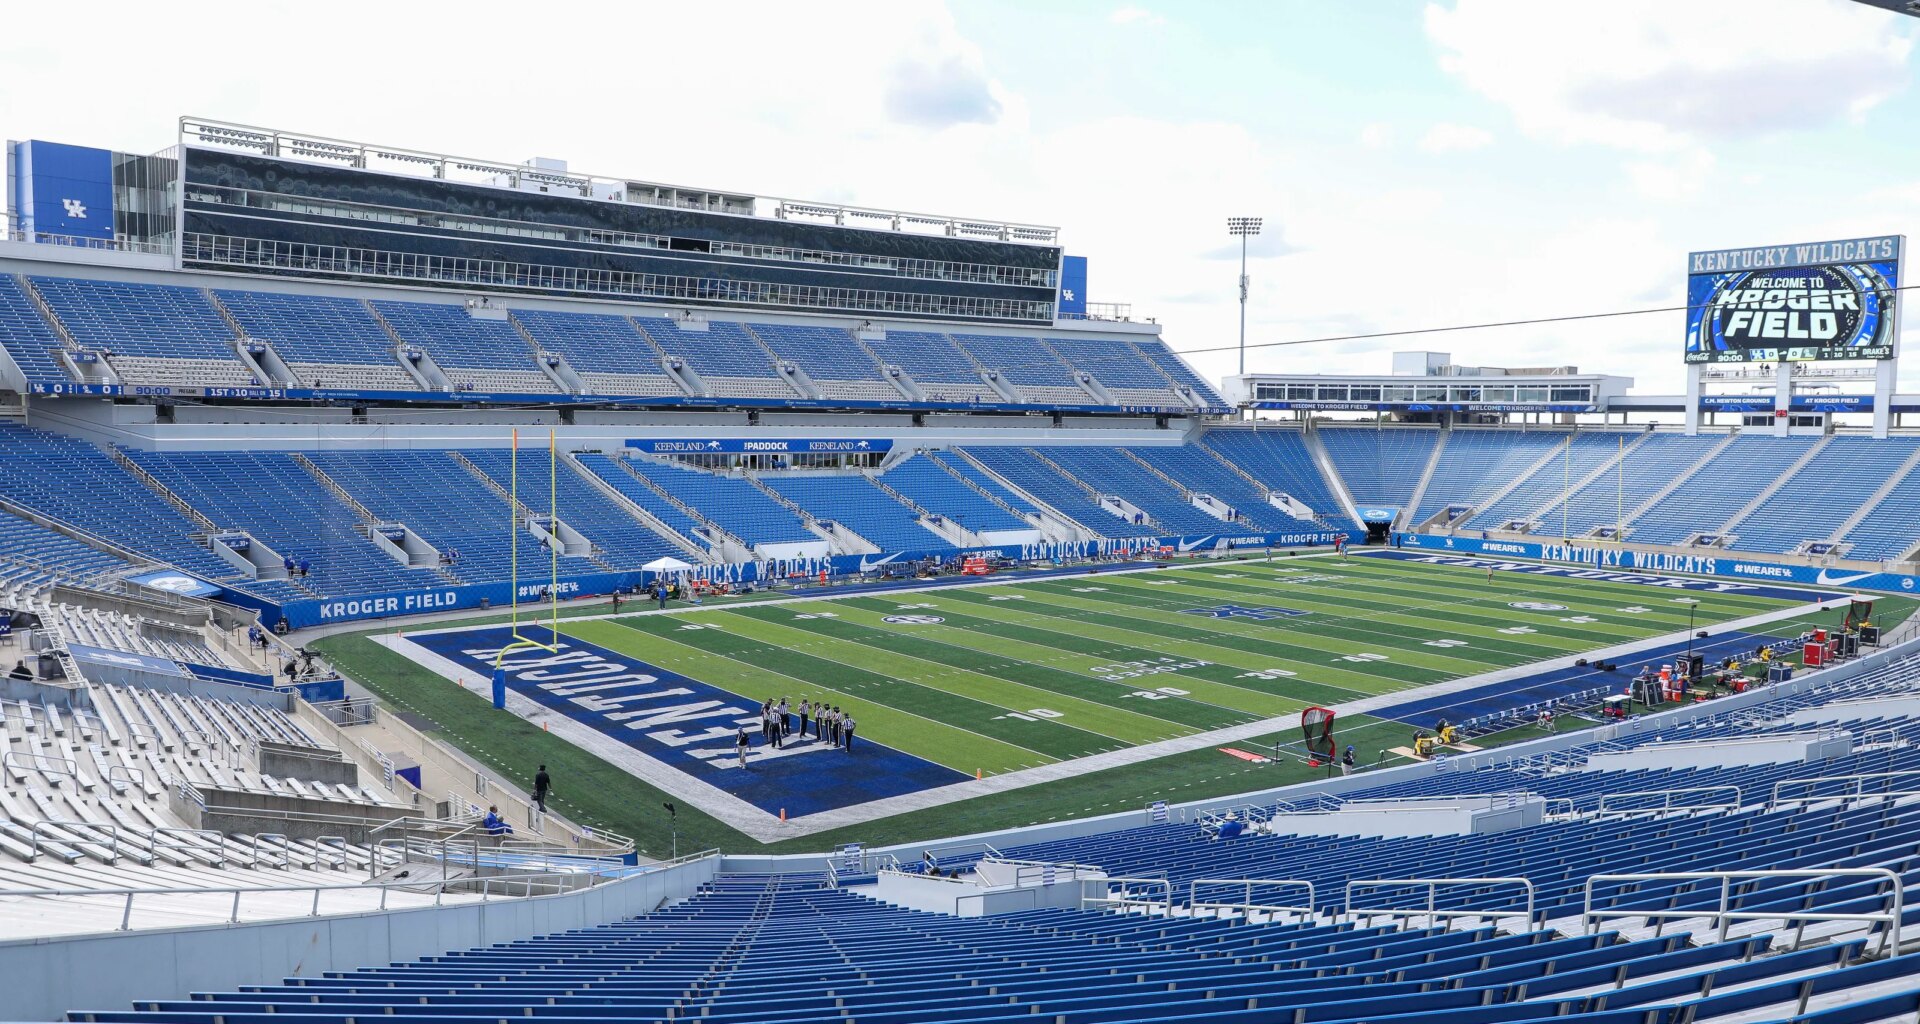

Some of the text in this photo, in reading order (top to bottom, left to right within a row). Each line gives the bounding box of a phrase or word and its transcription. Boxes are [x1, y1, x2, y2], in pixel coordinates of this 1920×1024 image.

[1693, 238, 1893, 272] KENTUCKY WILDCATS
[1750, 276, 1824, 289] WELCOME TO
[1714, 289, 1860, 311] KROGER
[1724, 311, 1838, 340] FIELD
[1862, 346, 1890, 356] DRAKE'S
[135, 386, 171, 395] 90:00
[210, 388, 229, 397] 1ST
[235, 388, 248, 397] 10
[269, 389, 281, 397] 15
[655, 442, 705, 451] KEENELAND
[747, 442, 788, 450] PADDOCK
[809, 441, 854, 450] KEENELAND
[1321, 532, 1347, 542] FIE
[1021, 536, 1157, 561] KENTUCKY WILDCATS
[755, 556, 832, 582] WLDCATS
[1633, 551, 1716, 575] WILDCATS
[320, 591, 457, 619] KROGER FIELD
[1131, 687, 1191, 701] 20
[1004, 707, 1066, 723] 10
